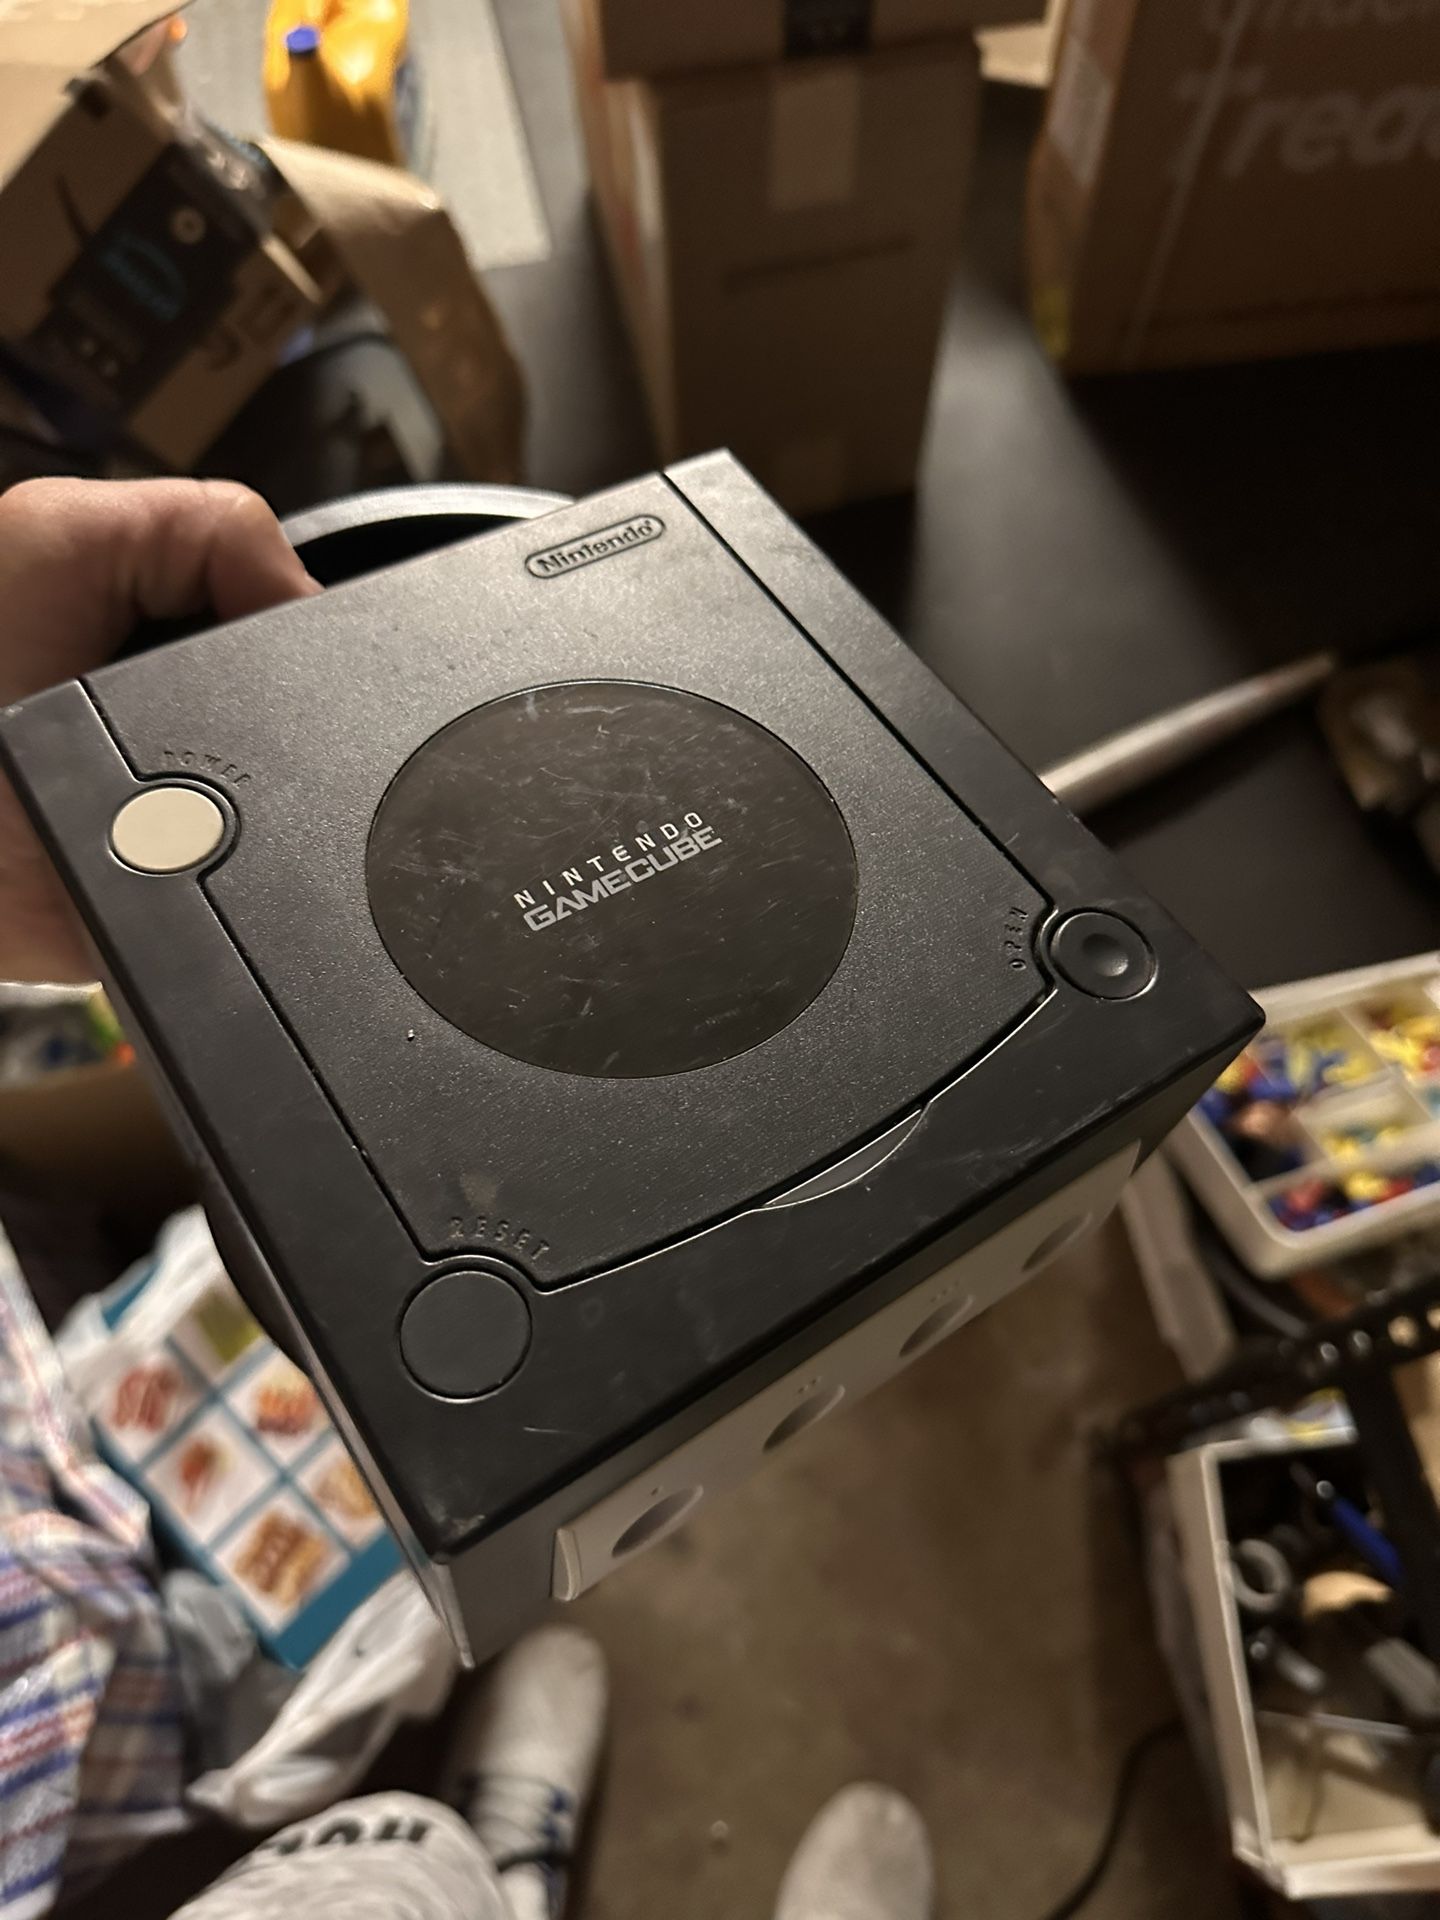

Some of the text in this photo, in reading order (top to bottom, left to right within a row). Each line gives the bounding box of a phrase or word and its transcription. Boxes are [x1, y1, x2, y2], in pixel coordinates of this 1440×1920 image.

[1170, 57, 1440, 180] Trea
[537, 521, 653, 572] Nintendo
[513, 811, 702, 909] NINTENDO
[523, 826, 723, 931] GAMECUBE
[1004, 906, 1029, 971] OPEN
[450, 1215, 551, 1260] RESET
